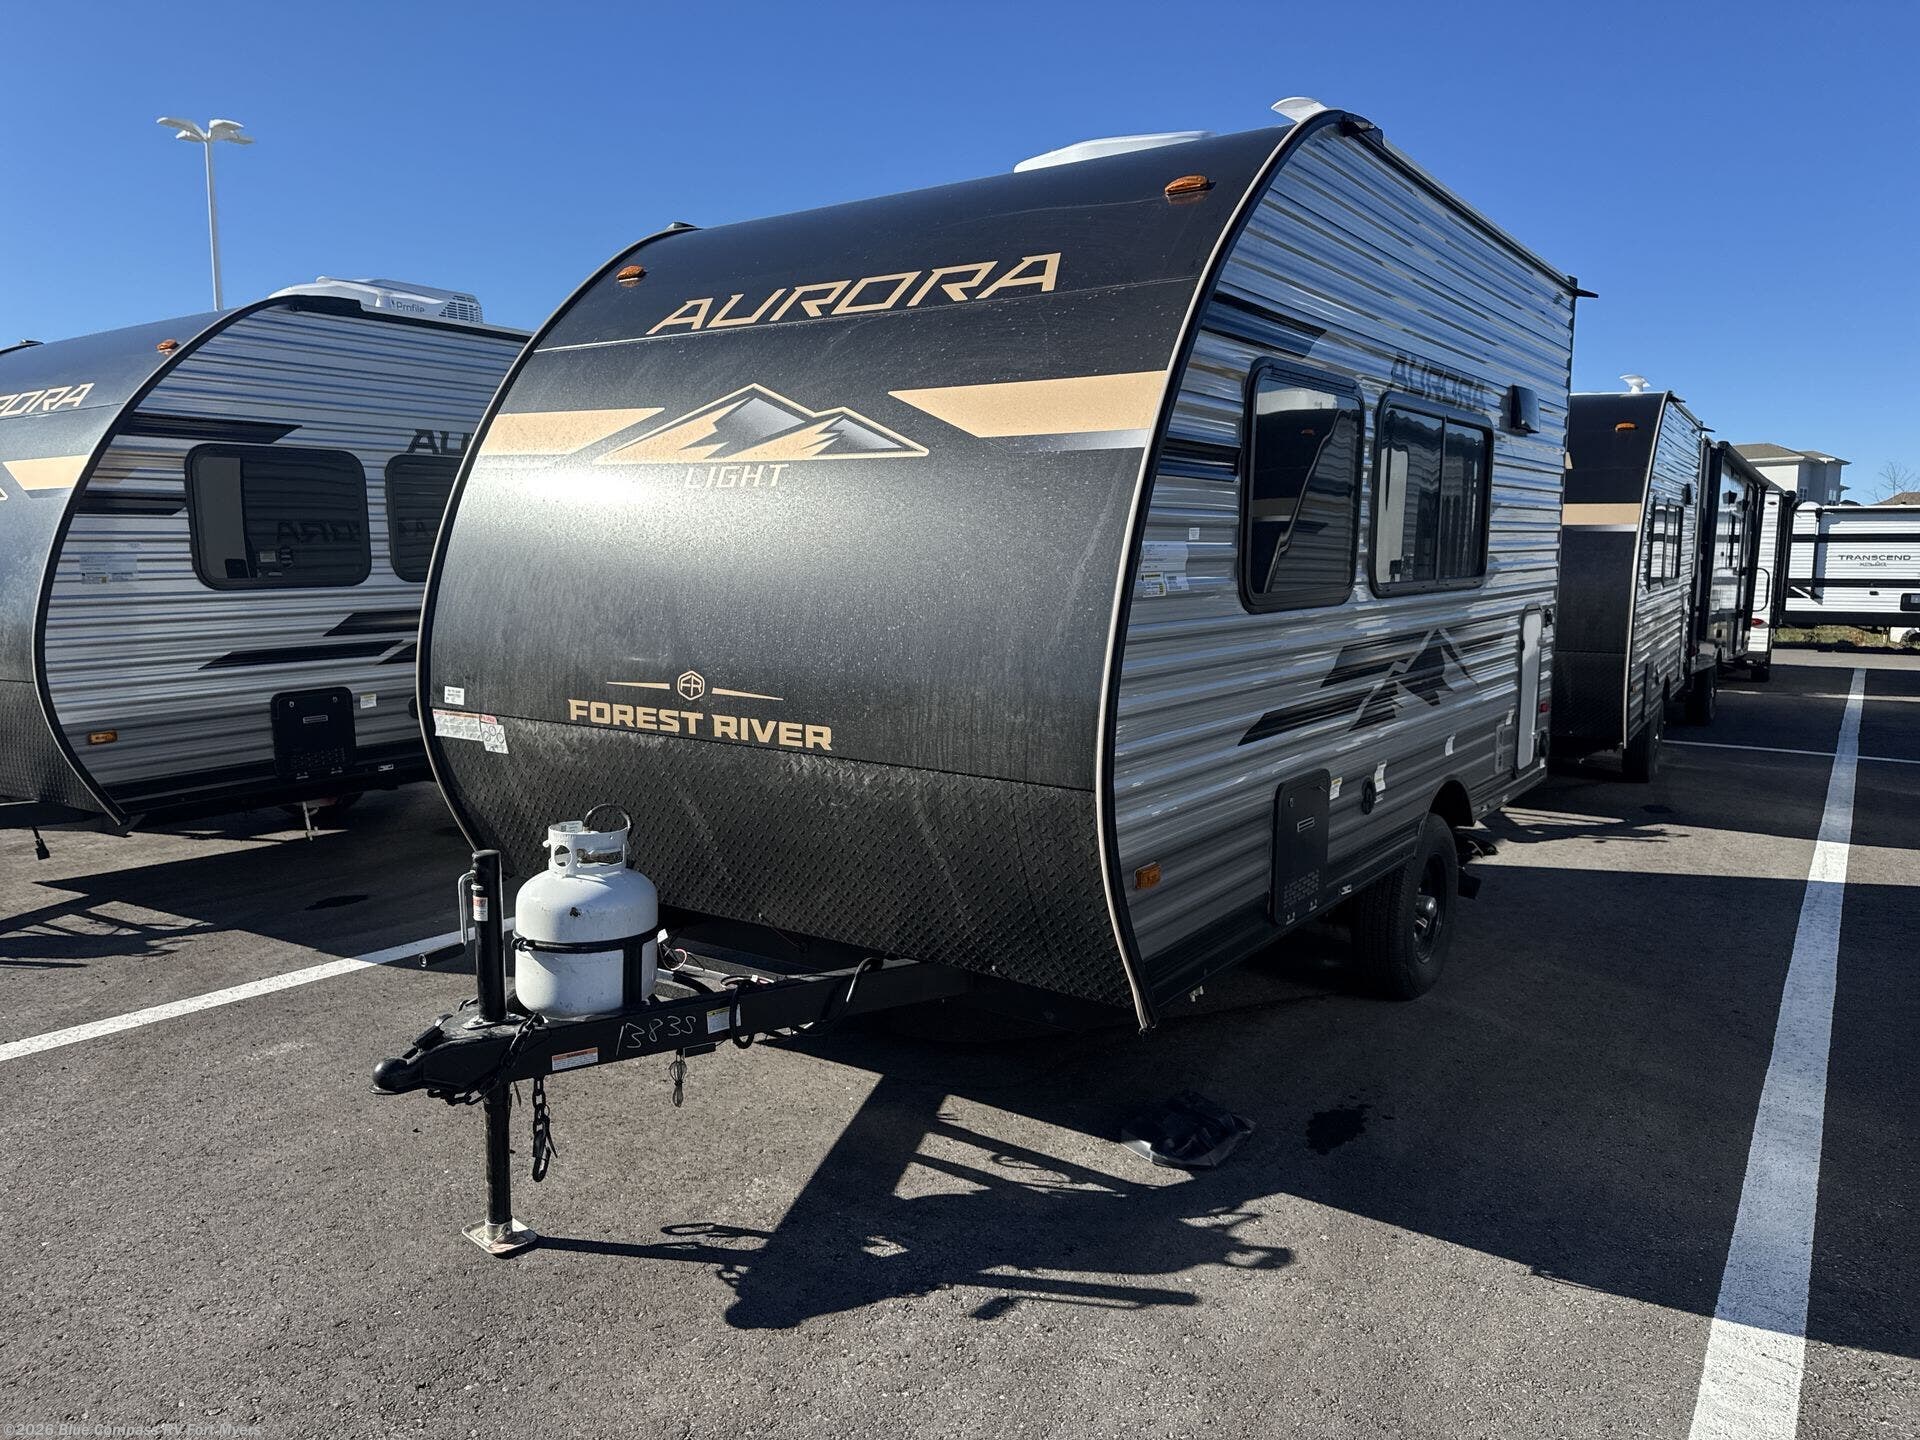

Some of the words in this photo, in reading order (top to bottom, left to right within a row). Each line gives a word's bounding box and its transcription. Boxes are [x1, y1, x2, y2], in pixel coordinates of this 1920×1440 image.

[646, 253, 1061, 335] AURORA
[406, 428, 475, 456] AU
[684, 463, 789, 488] LIGHT
[568, 699, 703, 734] FOREST
[711, 714, 832, 750] RIVER
